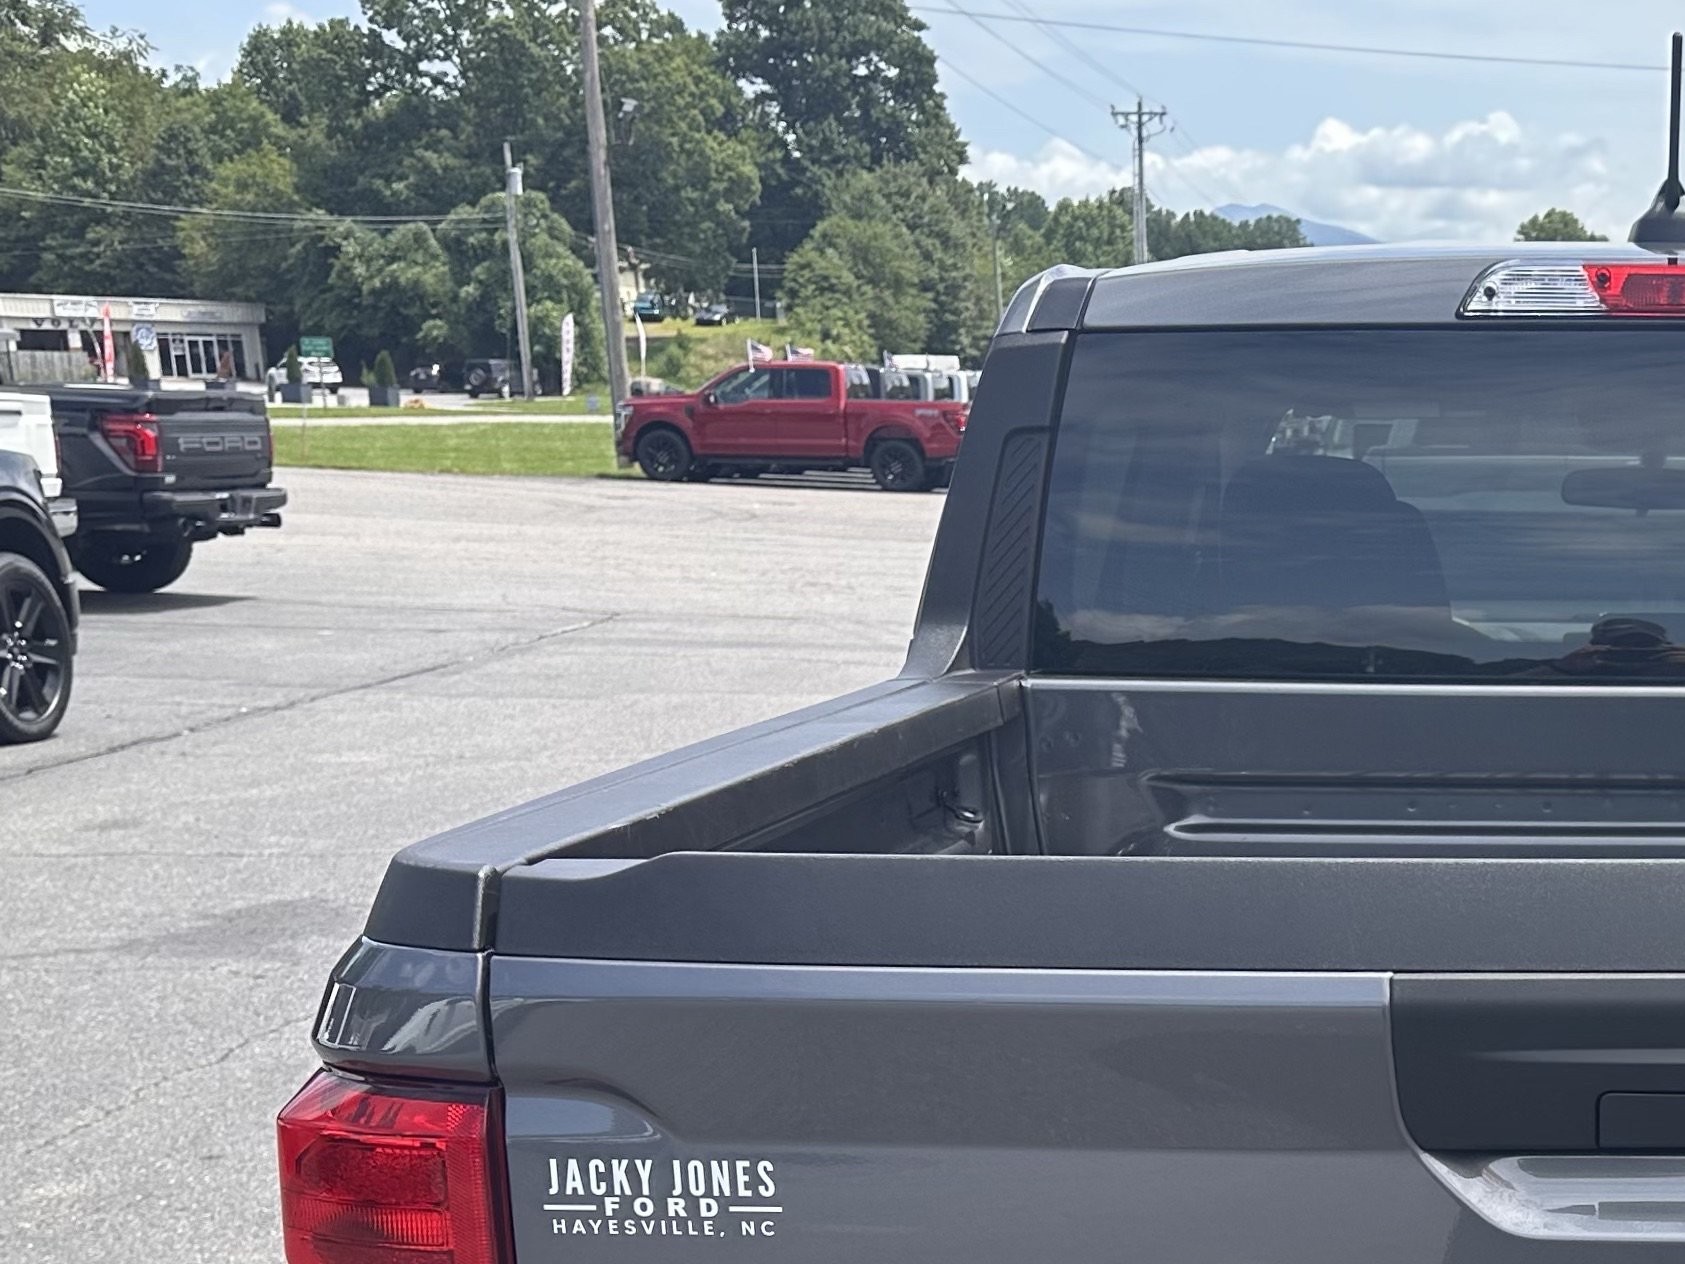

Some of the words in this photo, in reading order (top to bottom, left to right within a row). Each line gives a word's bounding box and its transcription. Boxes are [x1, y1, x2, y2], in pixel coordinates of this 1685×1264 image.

[32, 318, 112, 329] VOLV
[178, 436, 262, 453] FORD
[548, 1158, 653, 1196] JACKY
[672, 1159, 776, 1198] JONES
[603, 1196, 720, 1218] FORD
[552, 1219, 726, 1238] HAYESVILLE,
[741, 1220, 776, 1237] NC
